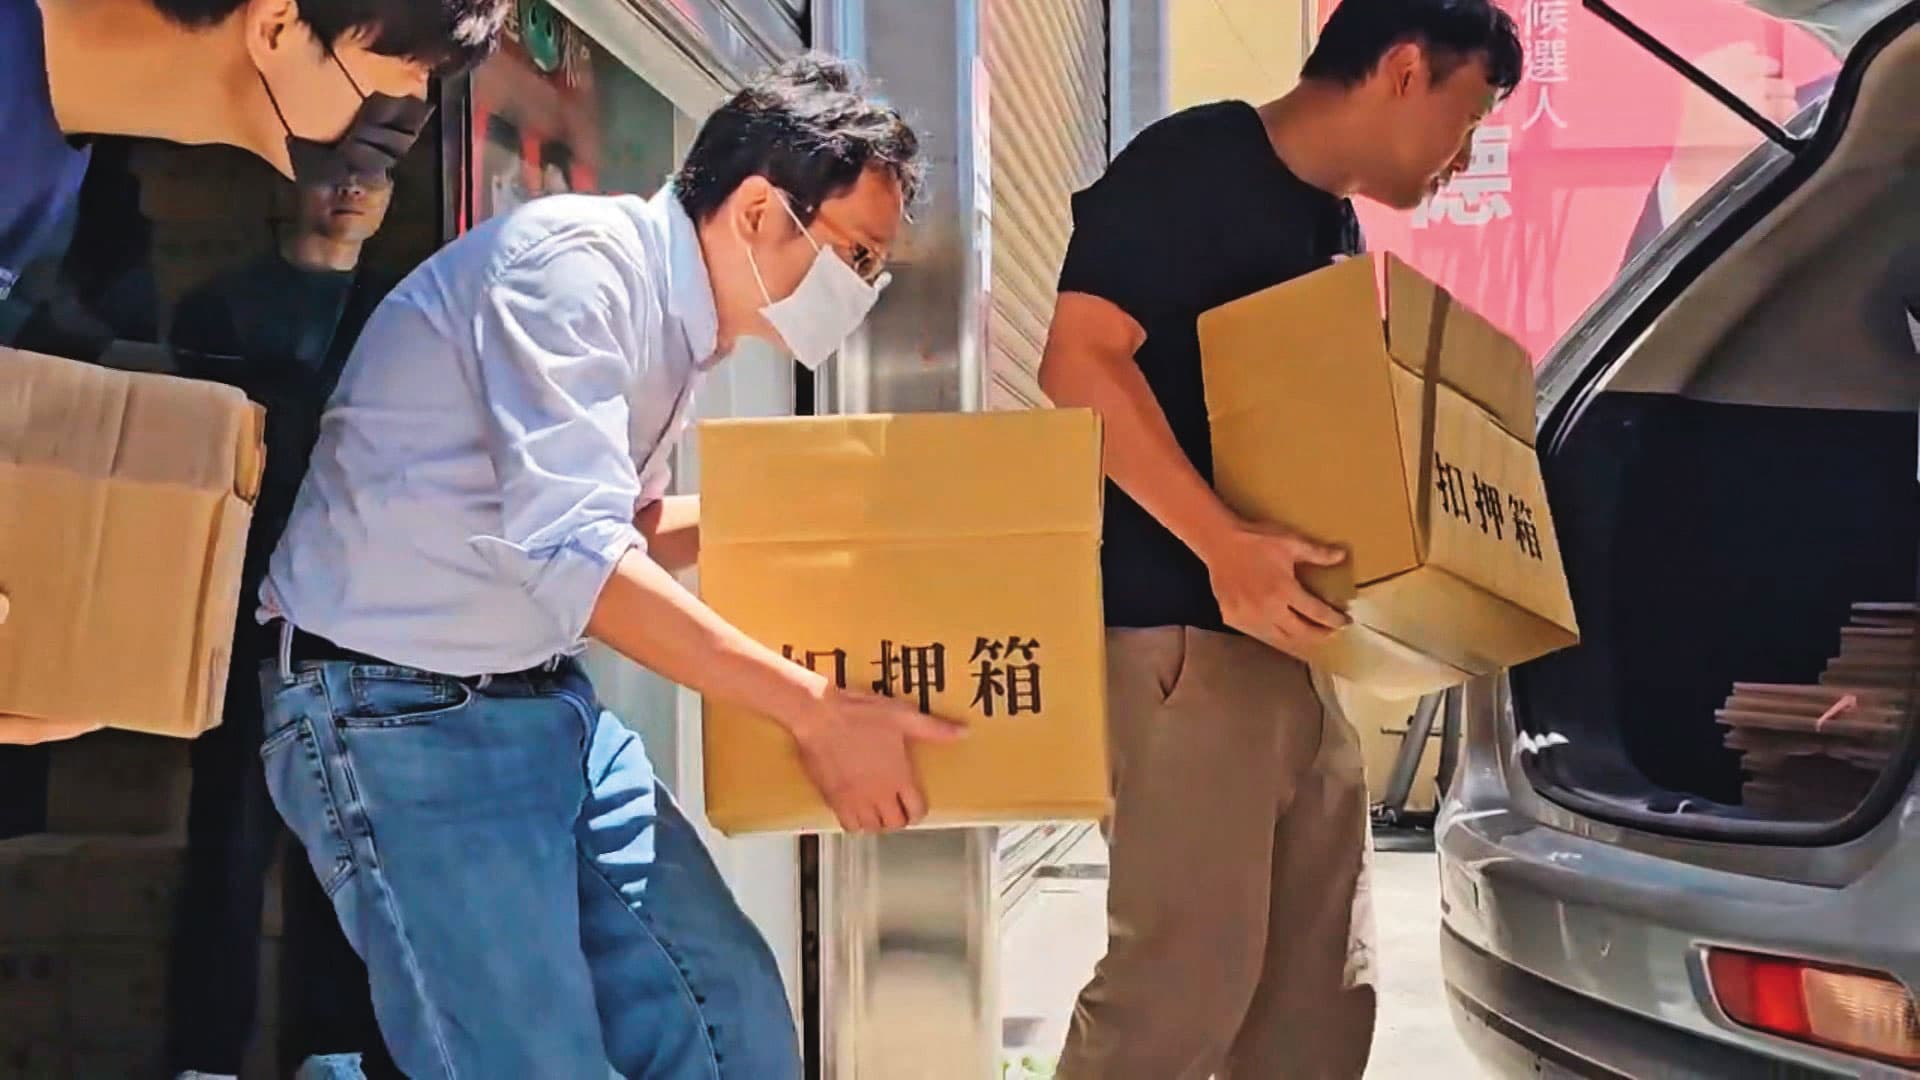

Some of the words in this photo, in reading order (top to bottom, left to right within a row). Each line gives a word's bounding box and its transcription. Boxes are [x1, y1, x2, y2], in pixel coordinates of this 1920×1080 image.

[1522, 0, 1568, 131] 候選人
[1435, 451, 1543, 561] 扣押箱
